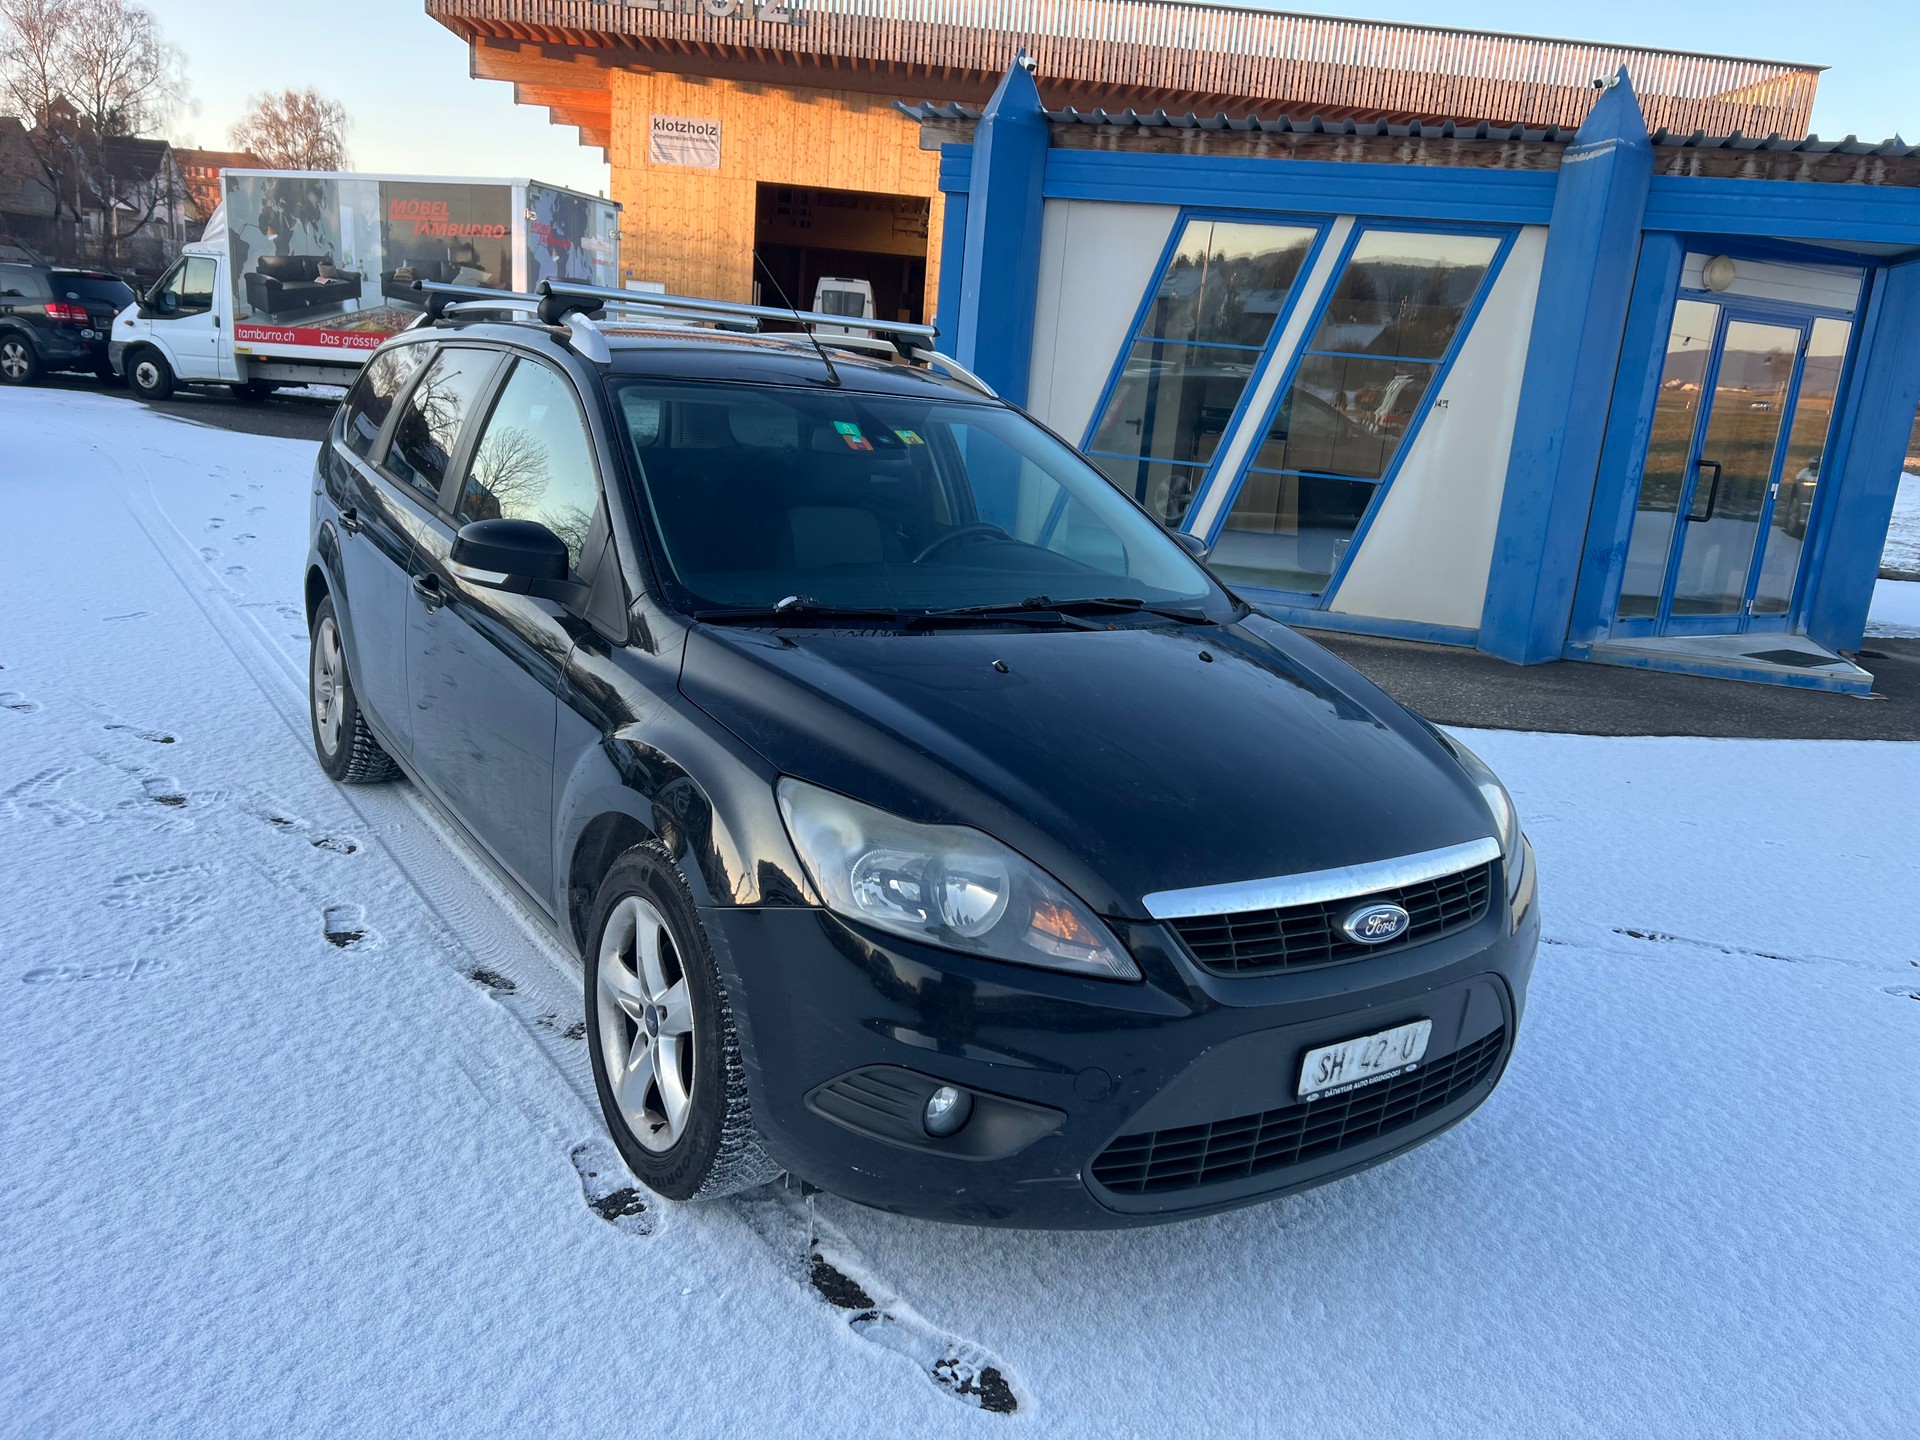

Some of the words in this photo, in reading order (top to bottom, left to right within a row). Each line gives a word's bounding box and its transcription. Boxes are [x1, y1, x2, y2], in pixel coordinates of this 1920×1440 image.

[653, 117, 717, 136] klotzholz
[389, 197, 449, 217] MÖBEL
[237, 328, 295, 343] tamburro.ch
[320, 332, 340, 345] Das
[342, 333, 381, 349] grösste
[1365, 913, 1398, 936] Ford
[1314, 1047, 1348, 1086] SH
[1360, 1037, 1389, 1071] 42
[1400, 1029, 1419, 1061] U
